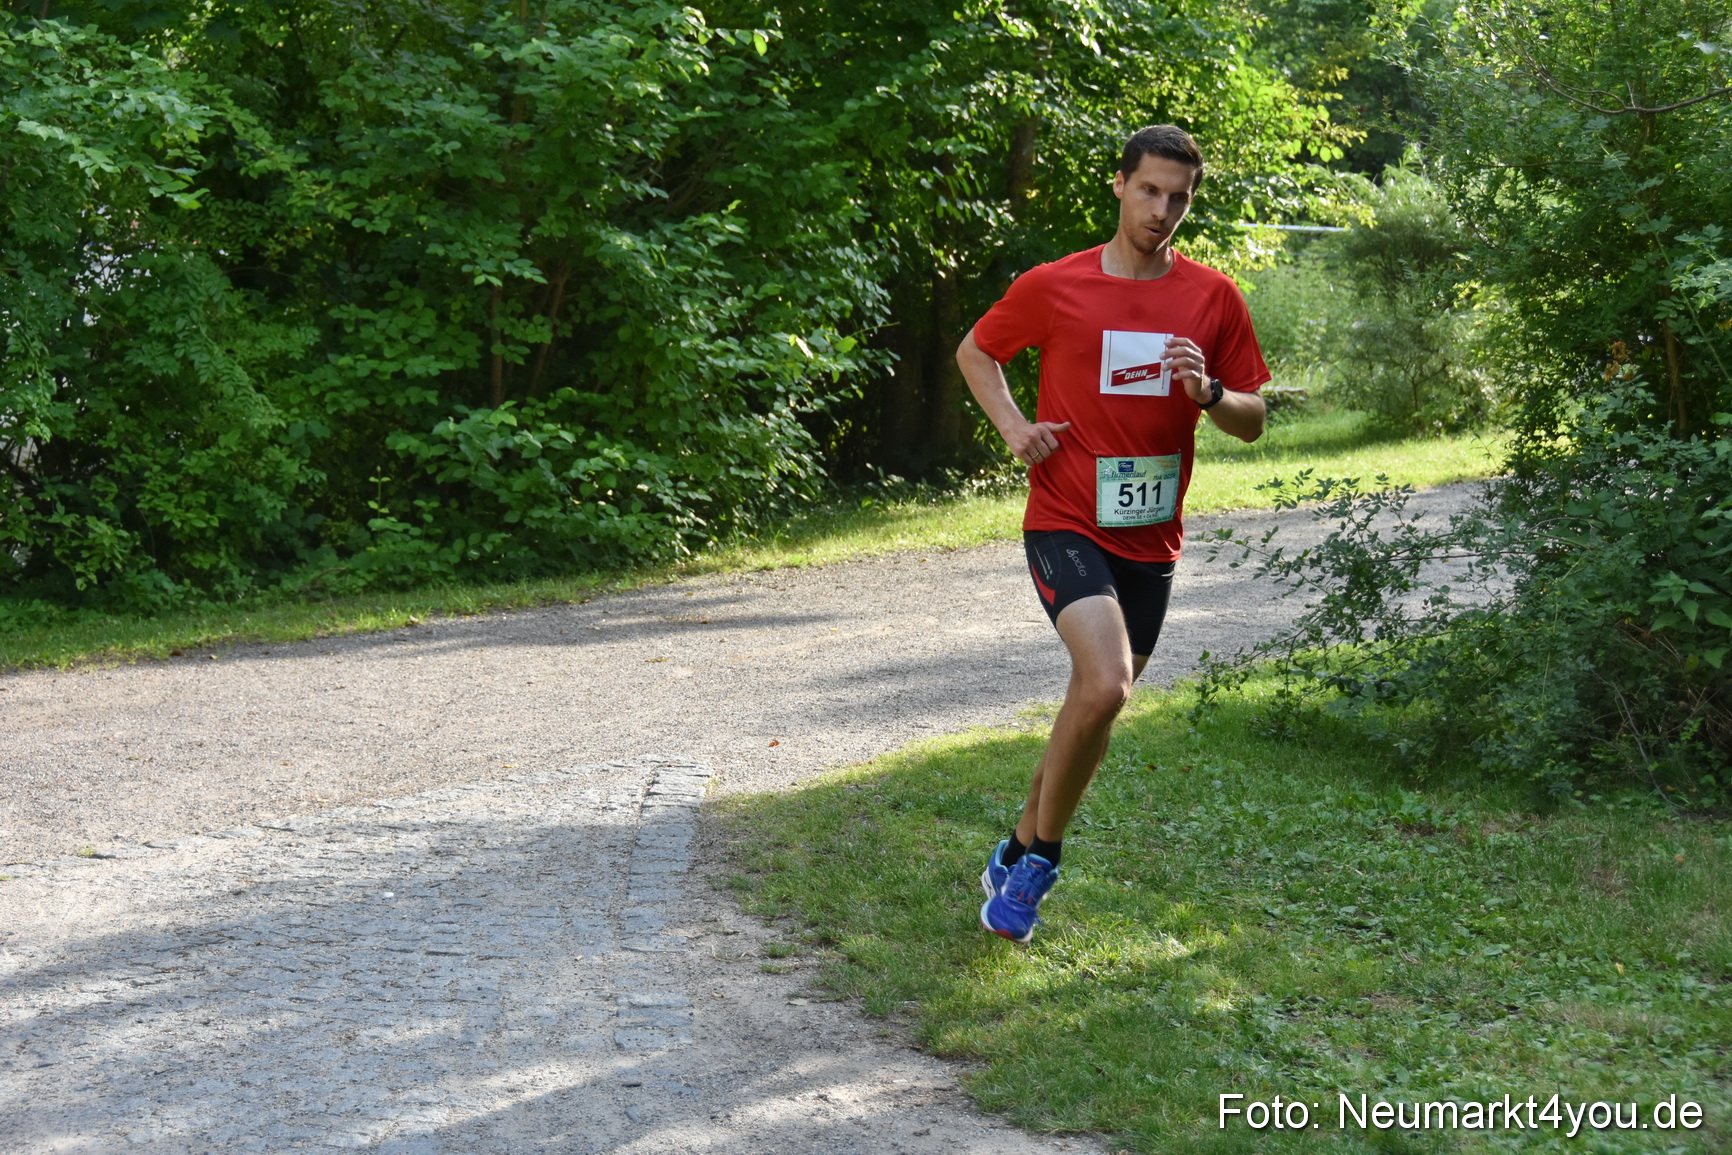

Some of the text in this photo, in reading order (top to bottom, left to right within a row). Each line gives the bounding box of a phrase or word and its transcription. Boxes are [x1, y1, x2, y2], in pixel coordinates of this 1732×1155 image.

[1124, 369, 1148, 380] DEHN
[1117, 481, 1162, 508] 511
[1113, 506, 1165, 517] Kürzinger Jürgen
